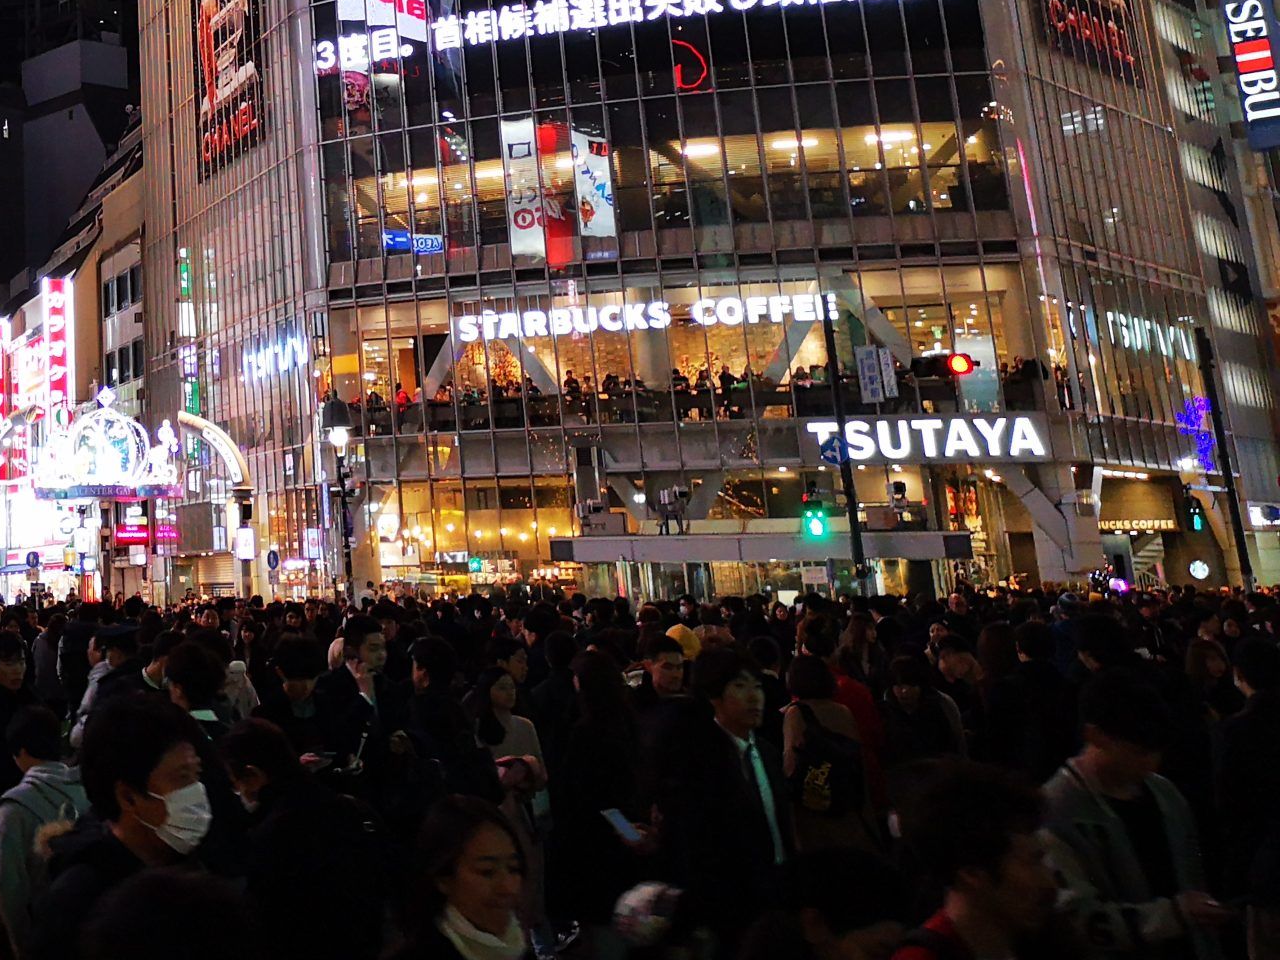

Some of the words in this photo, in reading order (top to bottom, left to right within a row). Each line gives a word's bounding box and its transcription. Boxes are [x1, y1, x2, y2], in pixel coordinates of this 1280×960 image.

[1224, 0, 1280, 122] SEIBU
[202, 101, 258, 162] CHANEL
[459, 302, 672, 342] STARBUCKS
[693, 293, 840, 327] COFFEE
[807, 415, 1047, 462] TSUTAYA
[1131, 519, 1175, 530] COFFEE
